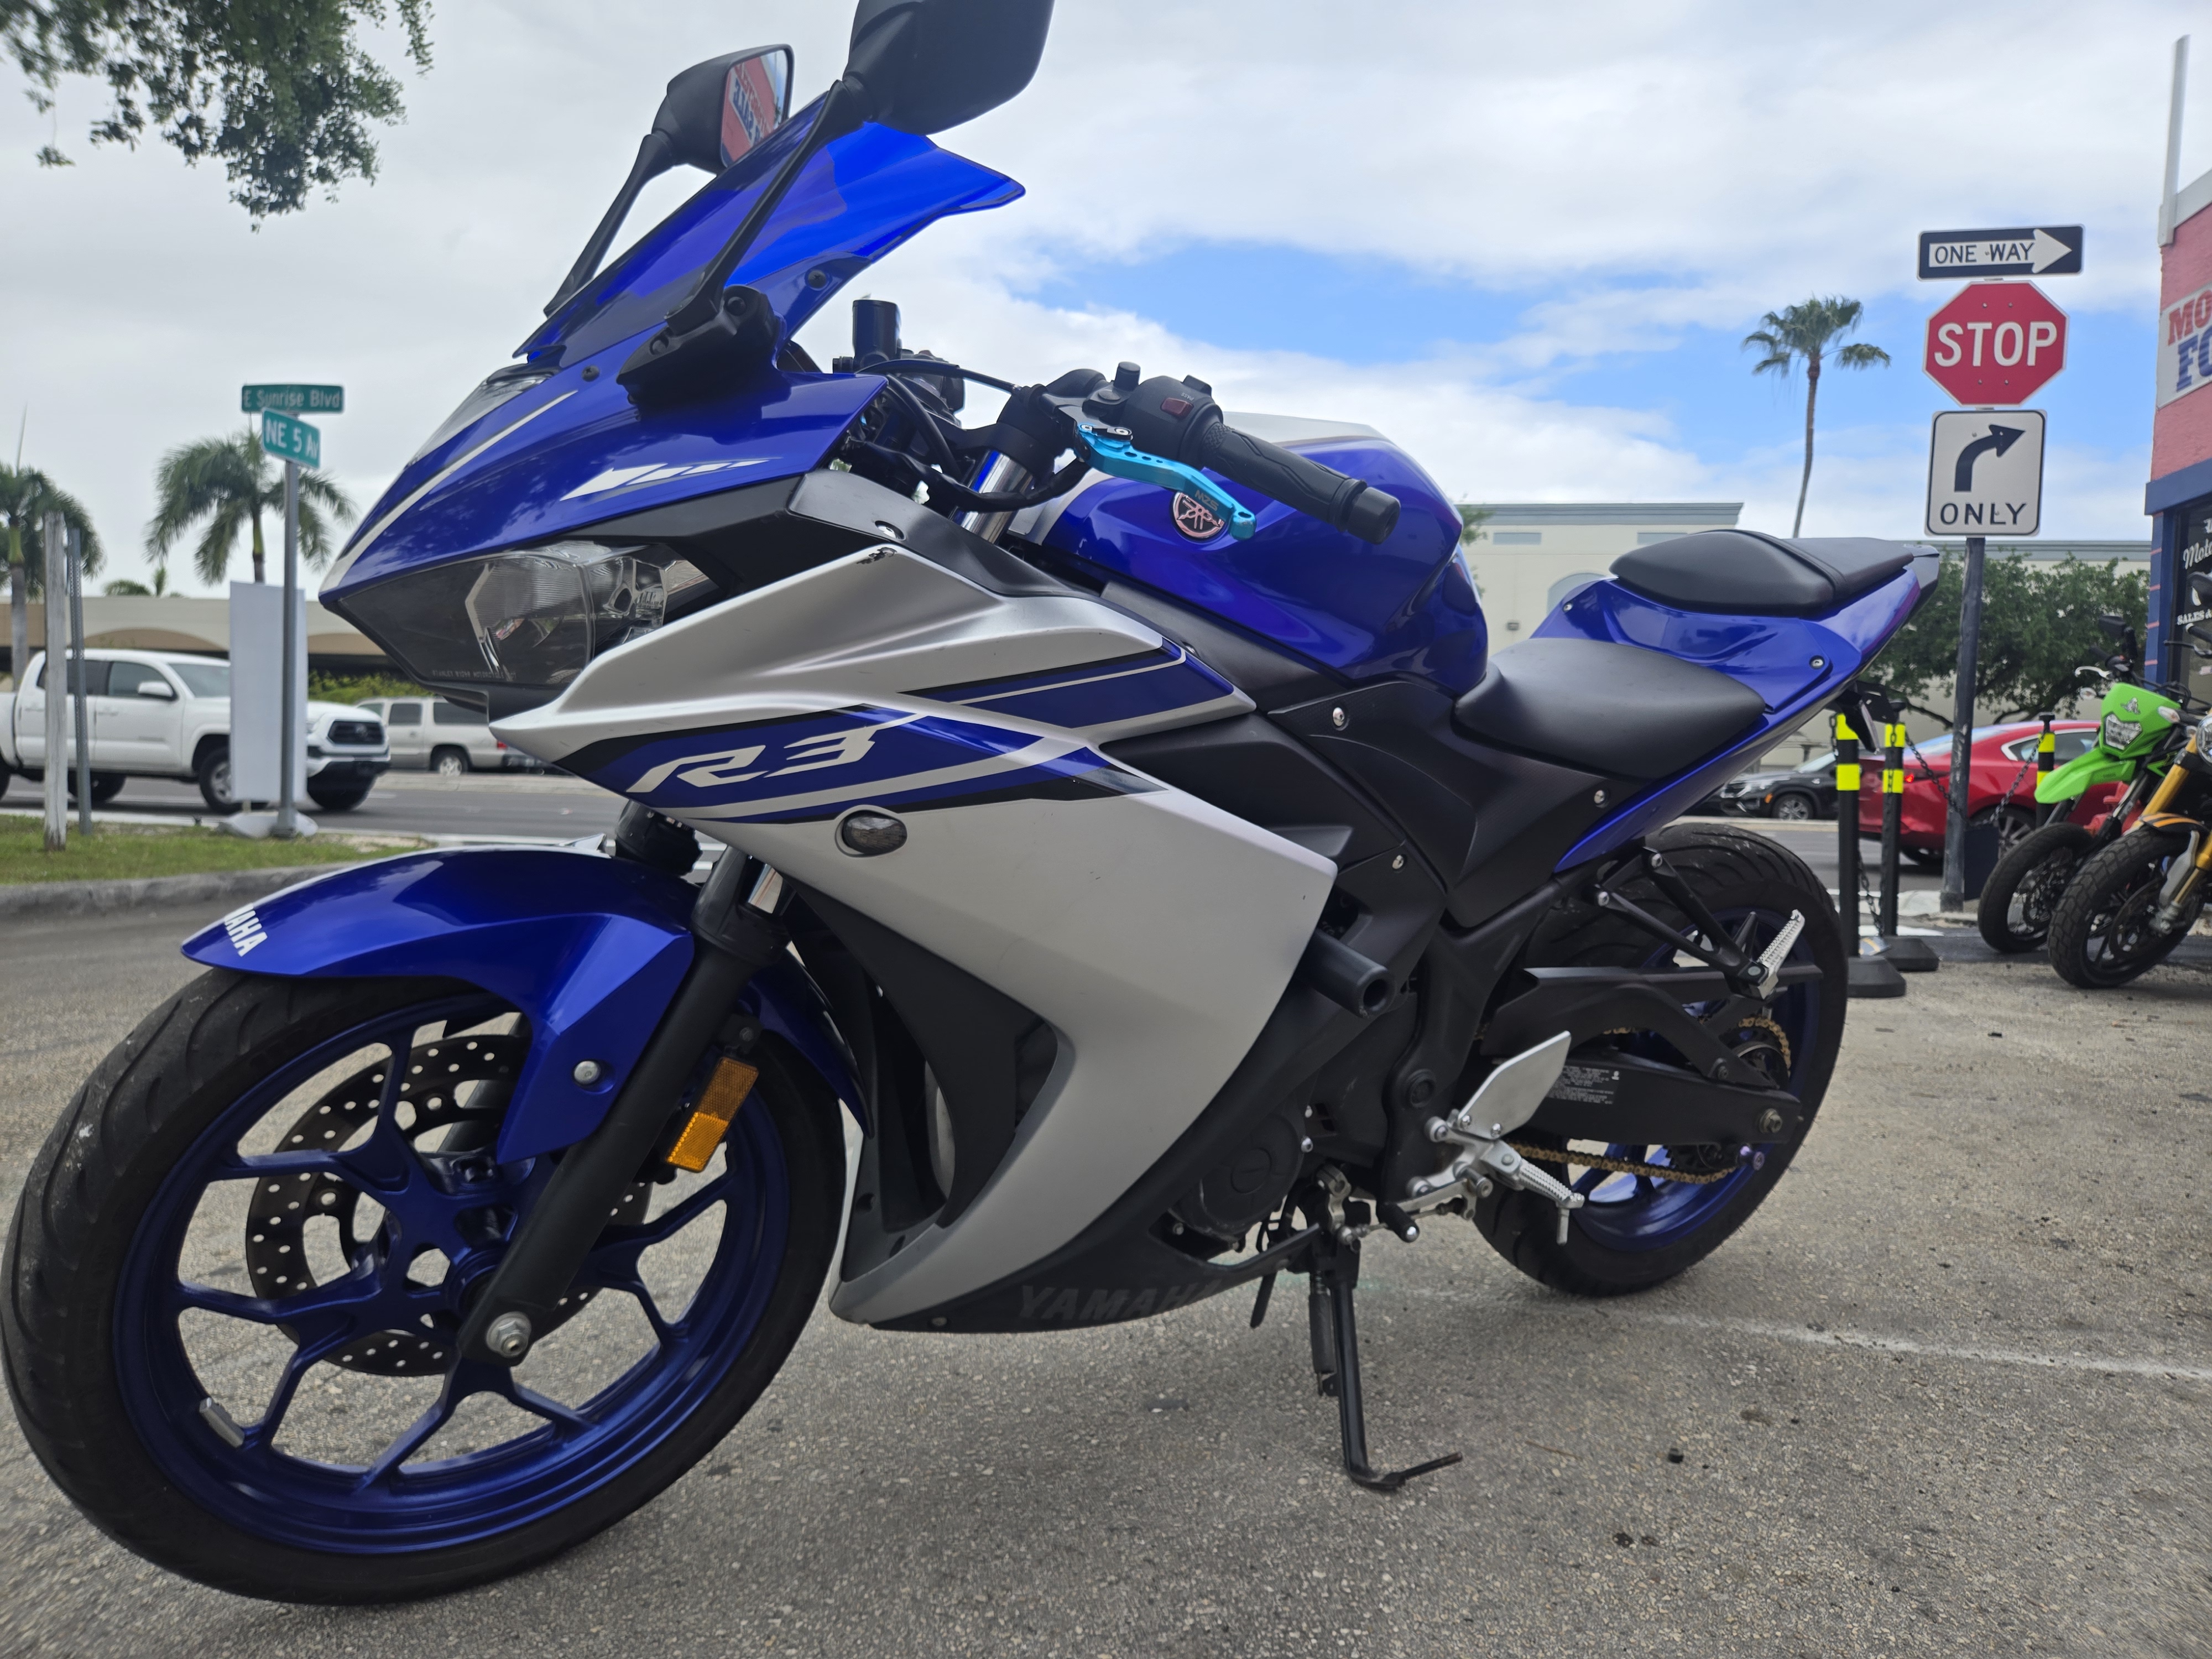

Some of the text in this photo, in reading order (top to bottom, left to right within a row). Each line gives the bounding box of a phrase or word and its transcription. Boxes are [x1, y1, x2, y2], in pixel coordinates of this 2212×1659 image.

[1934, 242, 2034, 264] ONE WAY
[1934, 321, 2058, 367] STOP
[243, 389, 340, 408] E Sunrise Blvd
[265, 418, 287, 448] NE
[293, 427, 302, 453] 5
[1194, 489, 1219, 512] MZS
[1939, 502, 2027, 526] ONLY
[2177, 609, 2205, 625] SALES
[625, 726, 876, 793] R3
